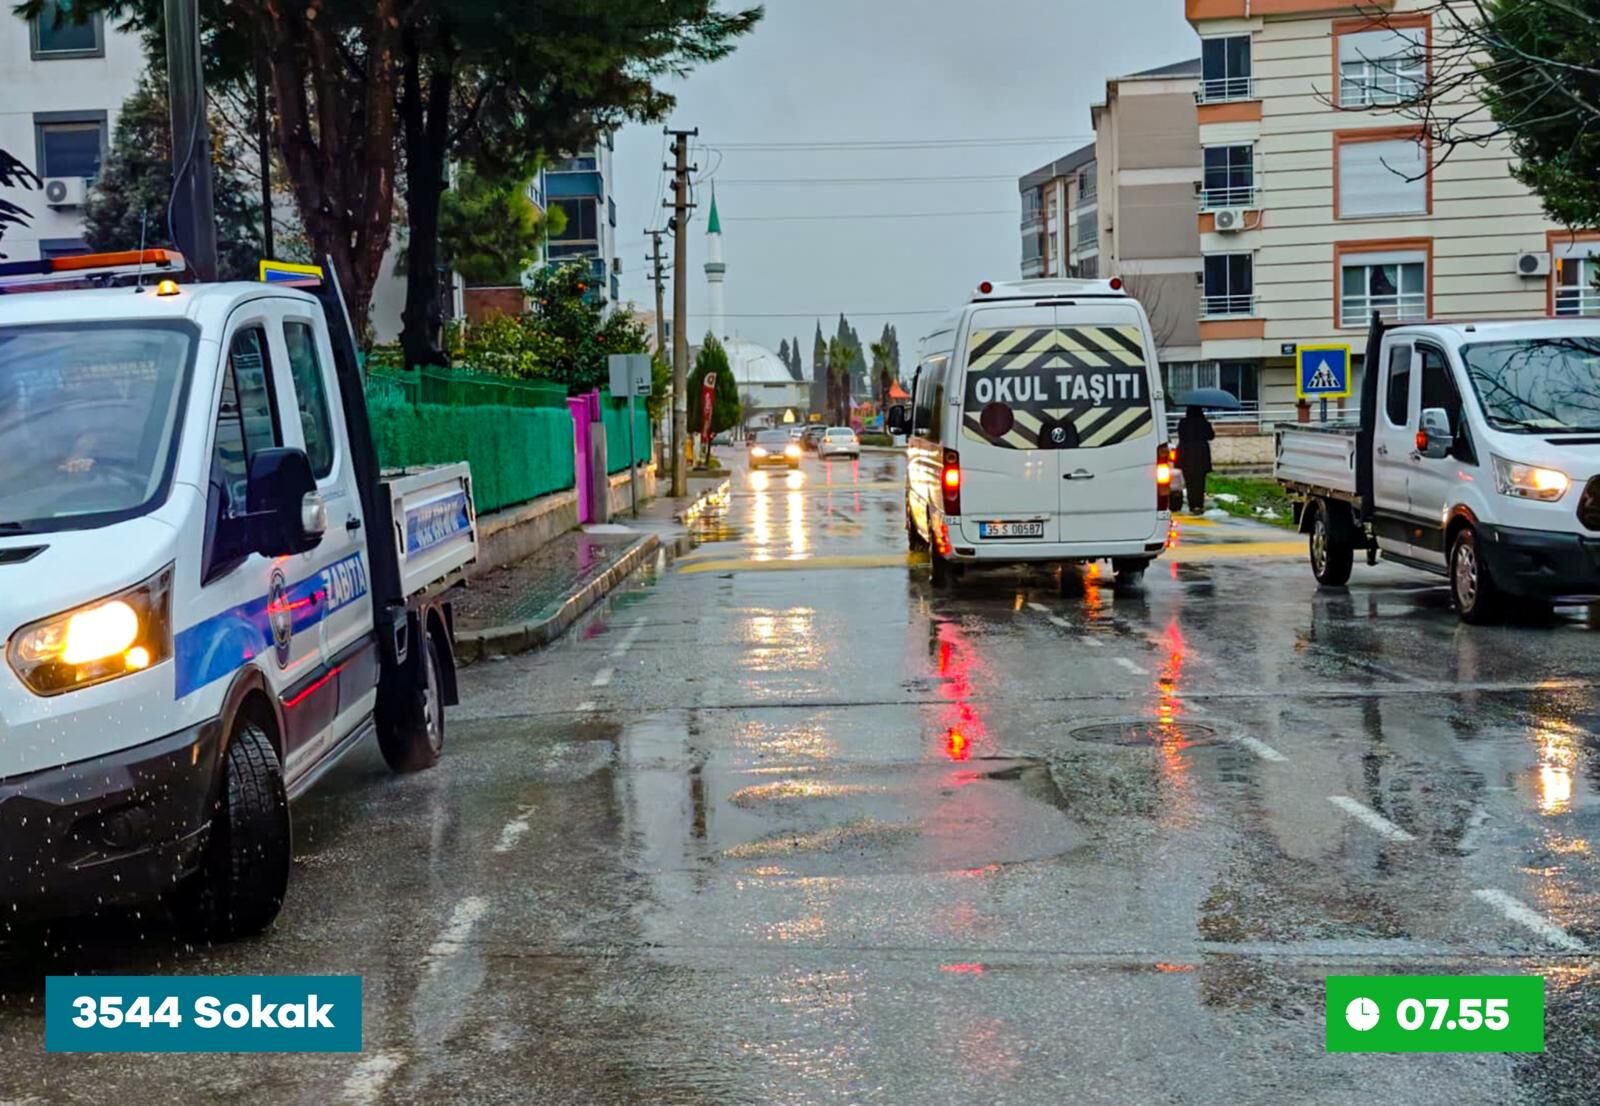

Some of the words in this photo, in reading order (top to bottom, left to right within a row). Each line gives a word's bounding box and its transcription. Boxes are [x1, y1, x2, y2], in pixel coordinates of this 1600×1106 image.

[975, 376, 1048, 403] OKUL
[1056, 373, 1139, 406] TAŞITI
[987, 525, 999, 535] 35
[1002, 524, 1008, 535] S
[1012, 524, 1040, 535] 00587
[321, 555, 367, 611] ZABITA
